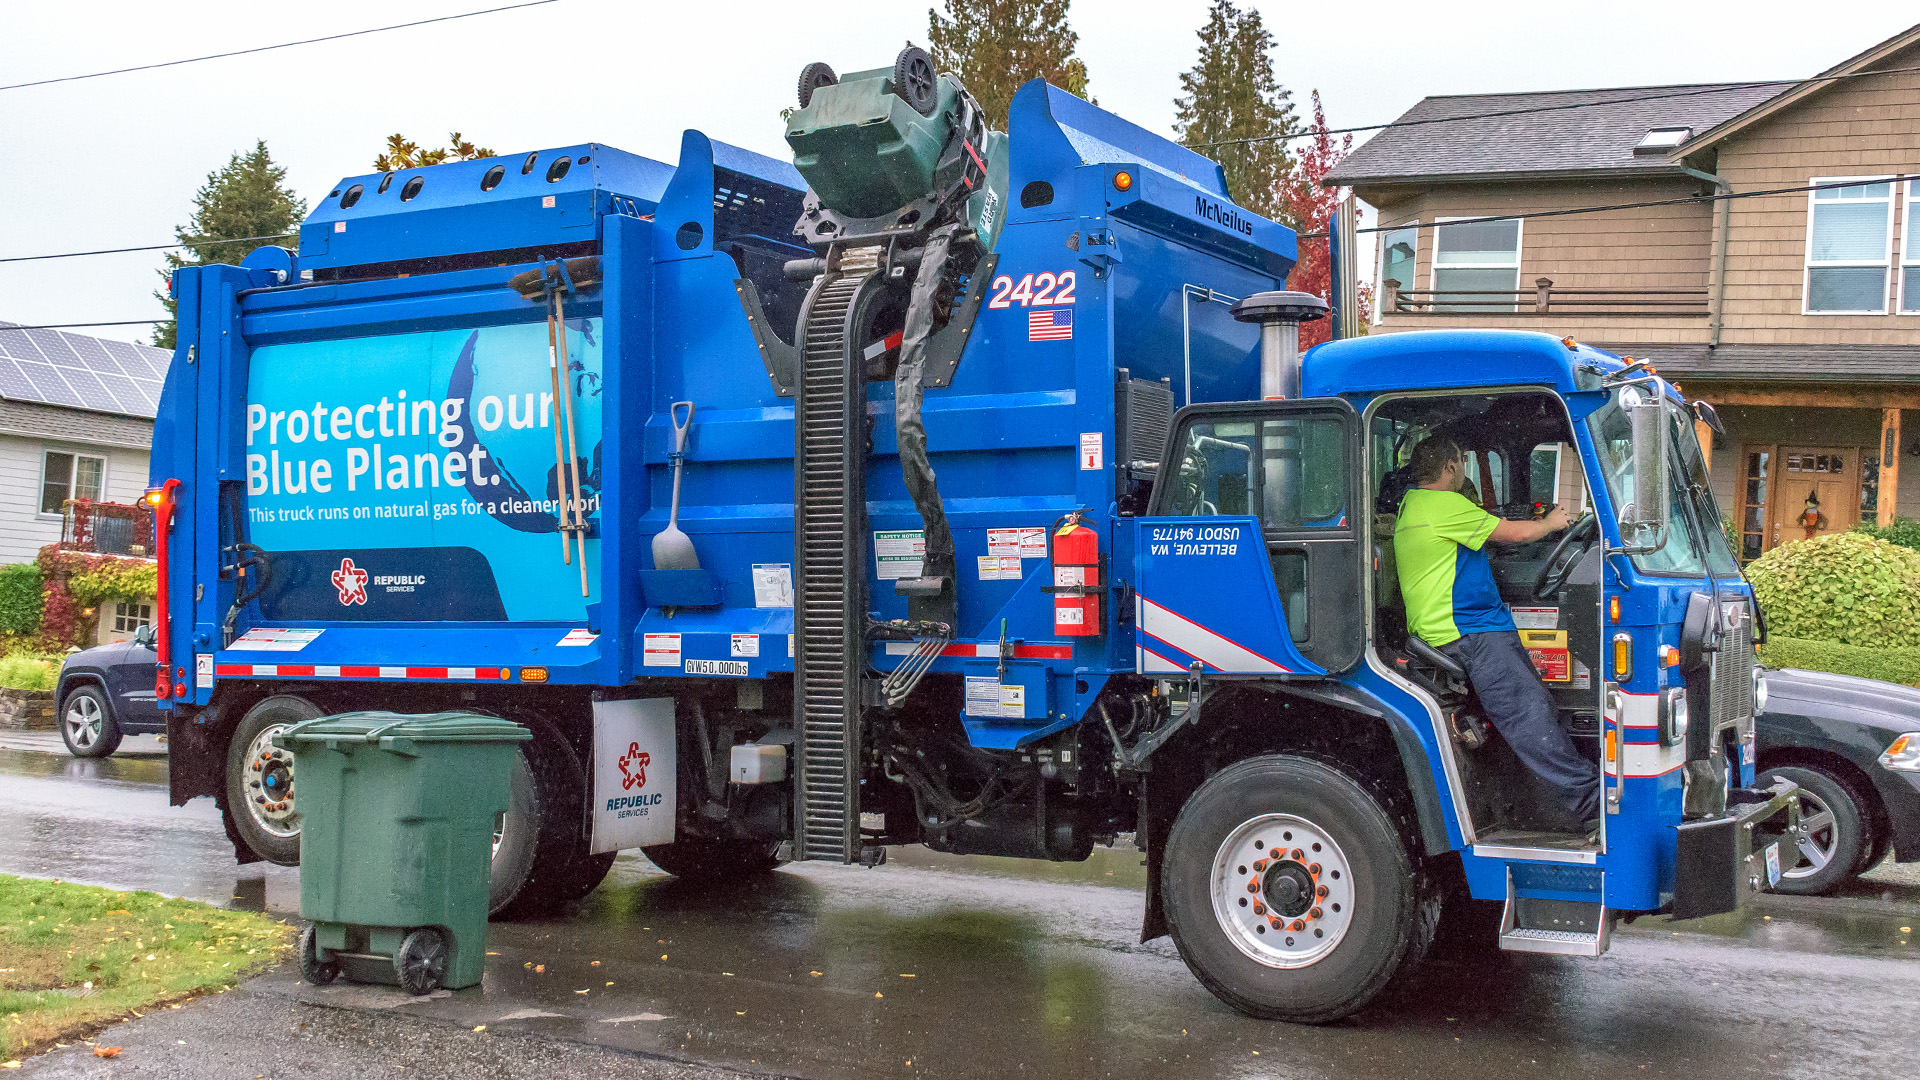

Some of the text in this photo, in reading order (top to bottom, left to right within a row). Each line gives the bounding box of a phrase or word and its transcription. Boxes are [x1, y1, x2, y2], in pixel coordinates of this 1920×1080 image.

[1195, 195, 1252, 236] McNeilus
[988, 270, 1076, 310] 2422
[246, 389, 553, 448] Protecting our
[246, 443, 500, 496] Blue Planet.
[249, 507, 275, 522] This
[278, 505, 315, 521] truck
[318, 507, 349, 520] runs
[352, 506, 371, 519] on
[374, 500, 429, 518] natural
[433, 502, 458, 521] gas
[461, 499, 483, 515] for
[487, 501, 497, 514] a
[500, 496, 560, 514] cleaner
[1153, 527, 1240, 540] USDOT 941775
[1151, 541, 1238, 555] BELLEVUE, WA
[374, 575, 426, 586] REPUBLIC
[606, 793, 662, 811] REPUBLIC
[617, 808, 649, 819] SERVICES
